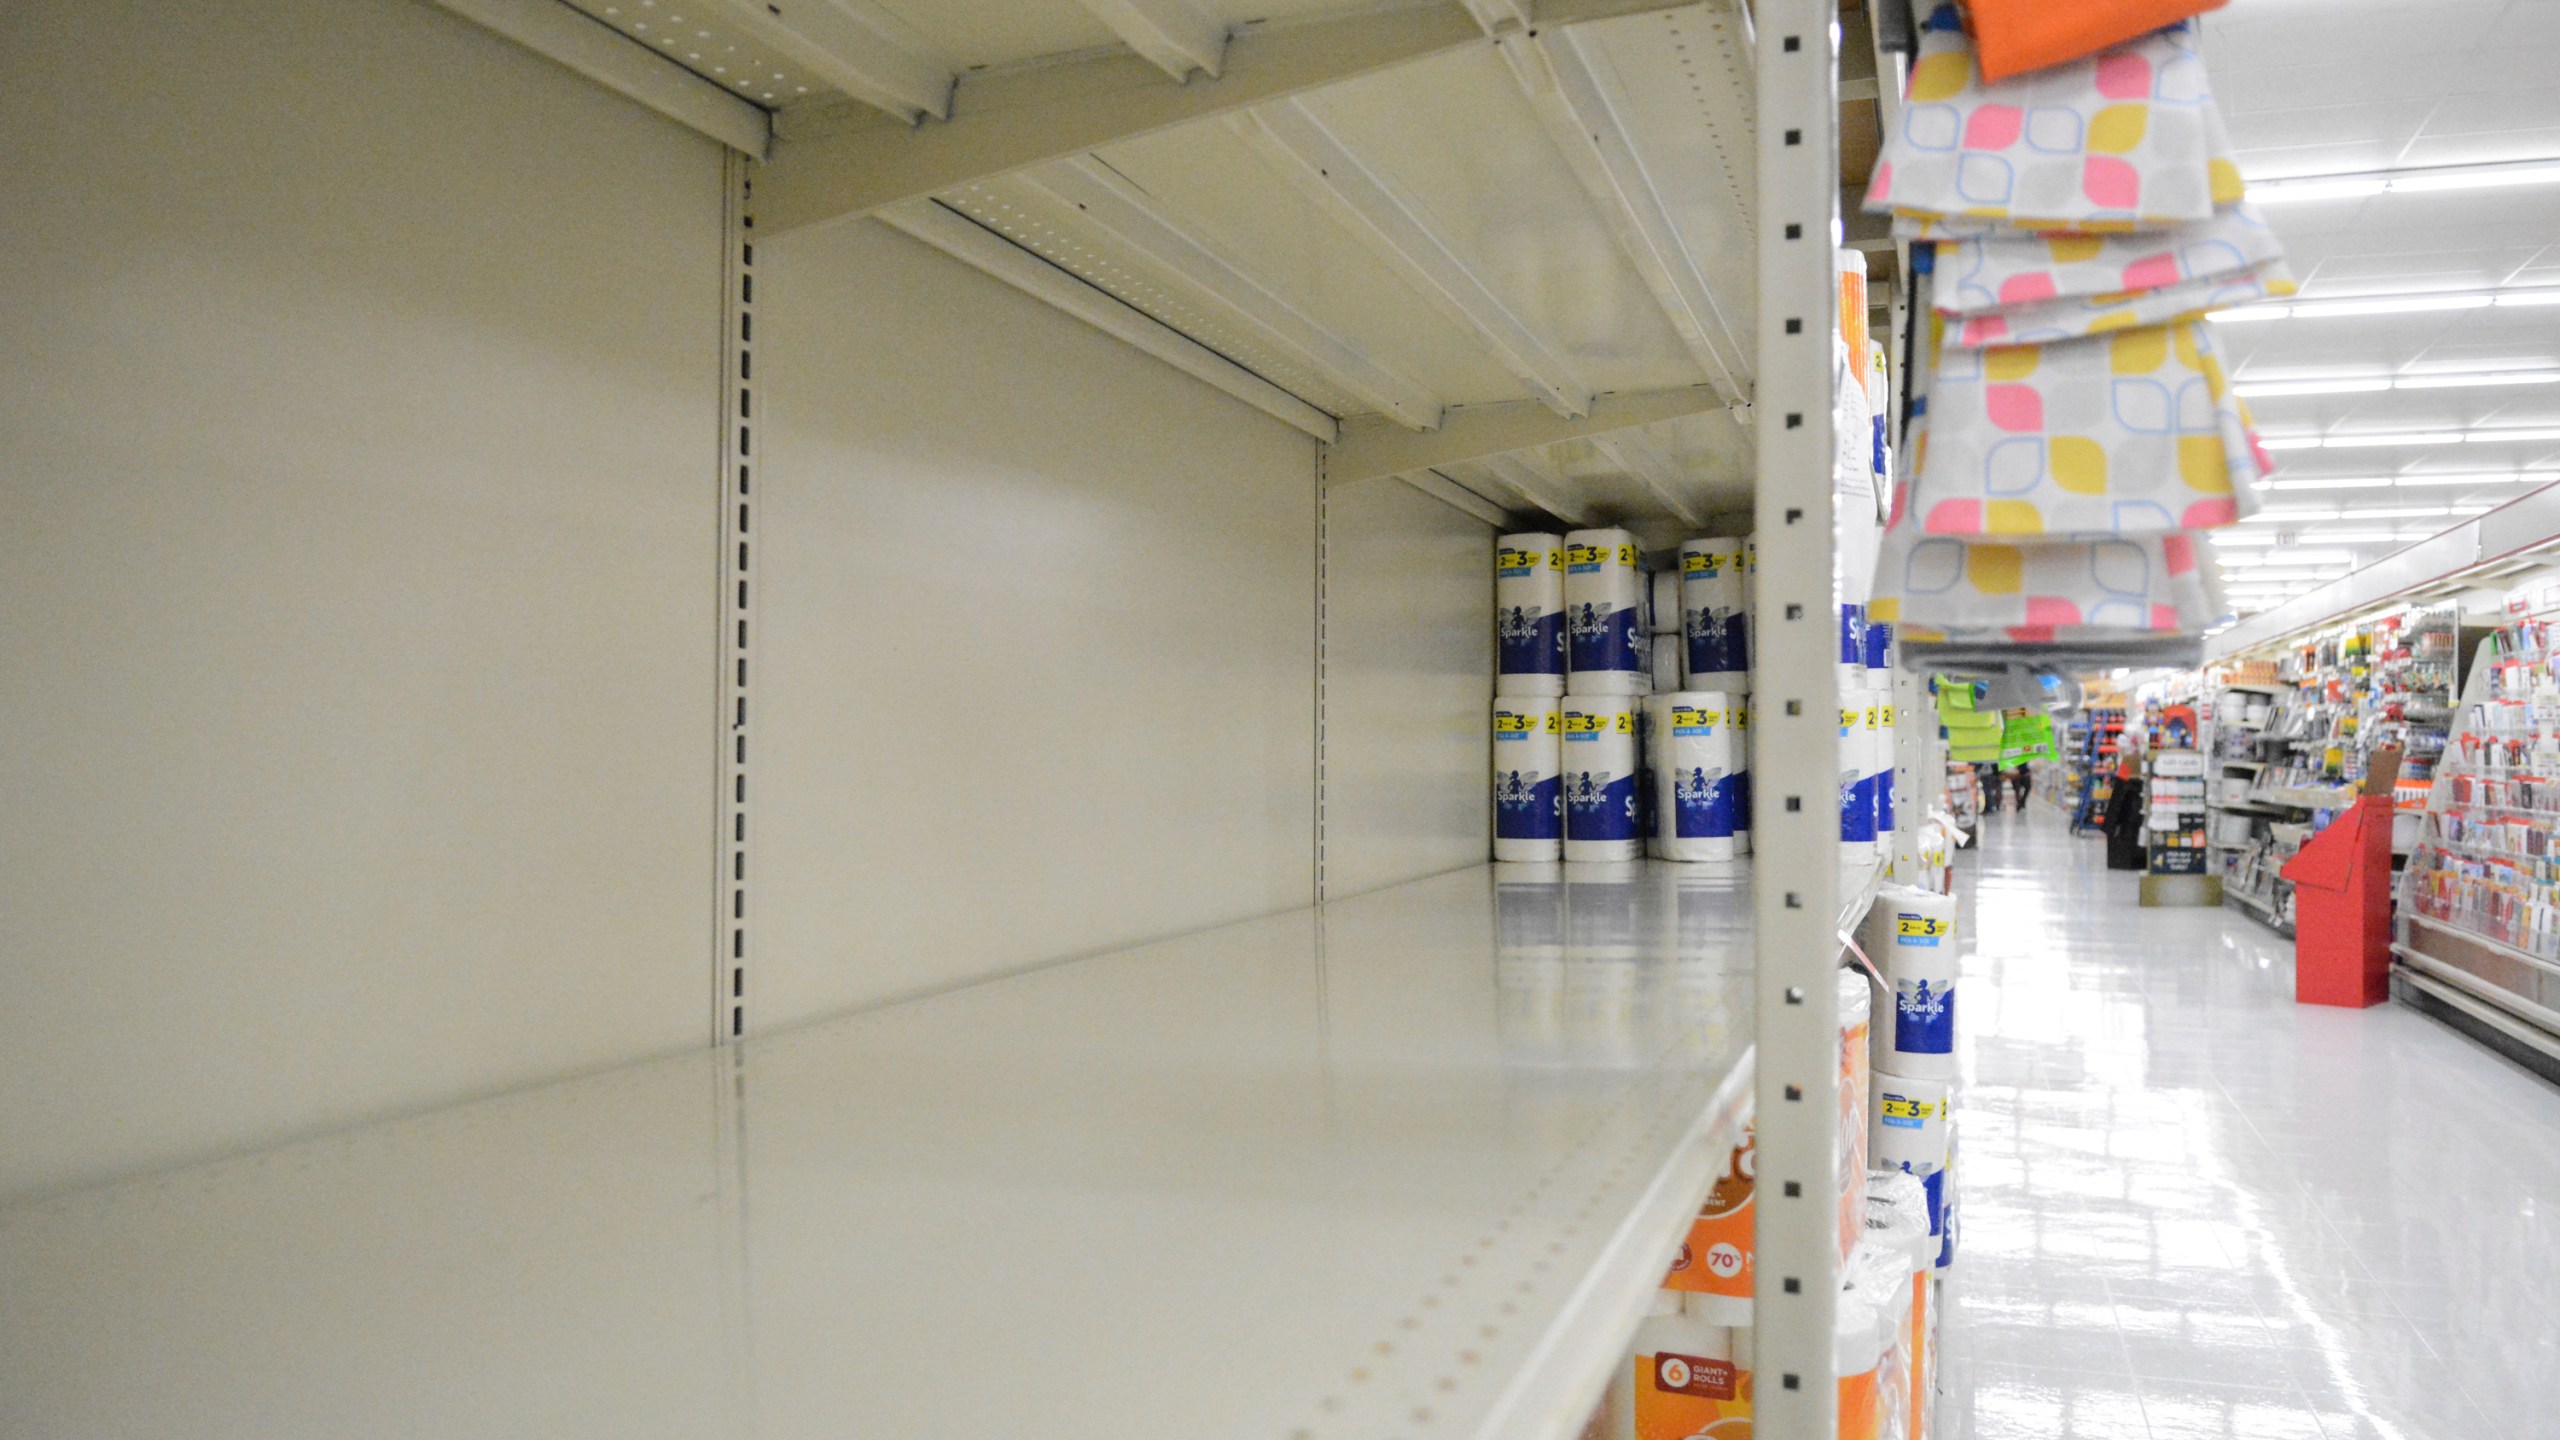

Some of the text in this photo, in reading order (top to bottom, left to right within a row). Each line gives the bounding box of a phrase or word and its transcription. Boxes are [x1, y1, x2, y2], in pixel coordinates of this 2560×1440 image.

[1517, 551, 1528, 566] 3
[1551, 553, 1558, 565] 2
[1587, 546, 1597, 561] 3
[1621, 548, 1628, 560] 2
[1703, 553, 1713, 568] 3
[1501, 626, 1538, 639] Sparkle
[1571, 622, 1609, 636] Sparkle
[1689, 625, 1727, 639] Sparkle
[1514, 714, 1524, 730] 3
[1548, 717, 1555, 729] 2
[1584, 715, 1595, 730] 3
[1619, 716, 1625, 729] 2
[1676, 710, 1707, 725] 2 3
[1739, 712, 1745, 725] 2
[1868, 711, 1875, 725] 2
[1884, 710, 1890, 722] 2
[1497, 791, 1535, 803] Sparkle
[1568, 792, 1607, 804] Sparkle
[1677, 788, 1719, 801] Sparkle
[1902, 922, 1909, 932] 2
[1924, 918, 1936, 935] 3
[1899, 1000, 1944, 1015] Sparkle
[1886, 1103, 1893, 1113] 2
[1908, 1100, 1920, 1116] 3
[1669, 1364, 1684, 1382] 6
[1693, 1374, 1725, 1385] ROLLS
